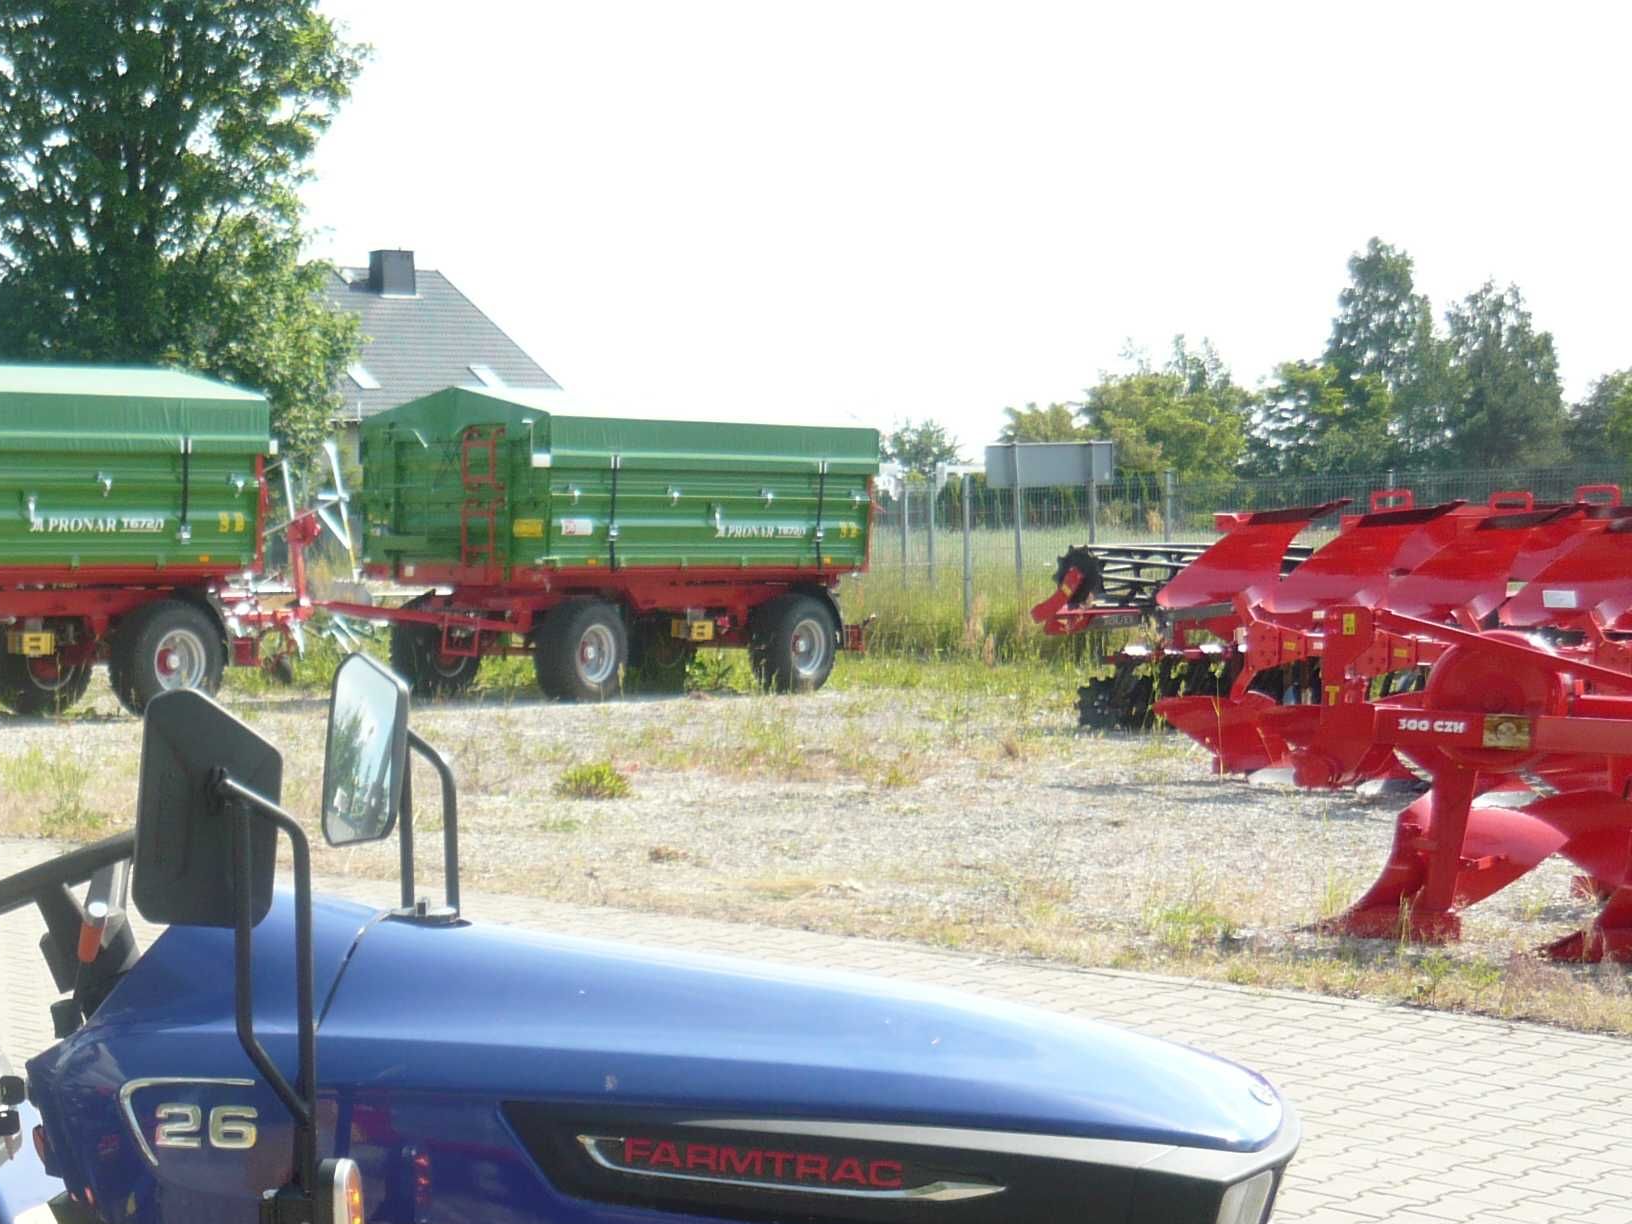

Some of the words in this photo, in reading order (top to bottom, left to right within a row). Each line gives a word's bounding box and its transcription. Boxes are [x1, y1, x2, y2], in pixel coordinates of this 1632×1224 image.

[47, 517, 117, 533] PRONAR
[727, 524, 775, 538] PRONAR
[1433, 720, 1466, 734] CZH
[155, 1102, 258, 1149] 26
[623, 1136, 904, 1188] FARMTRAC
